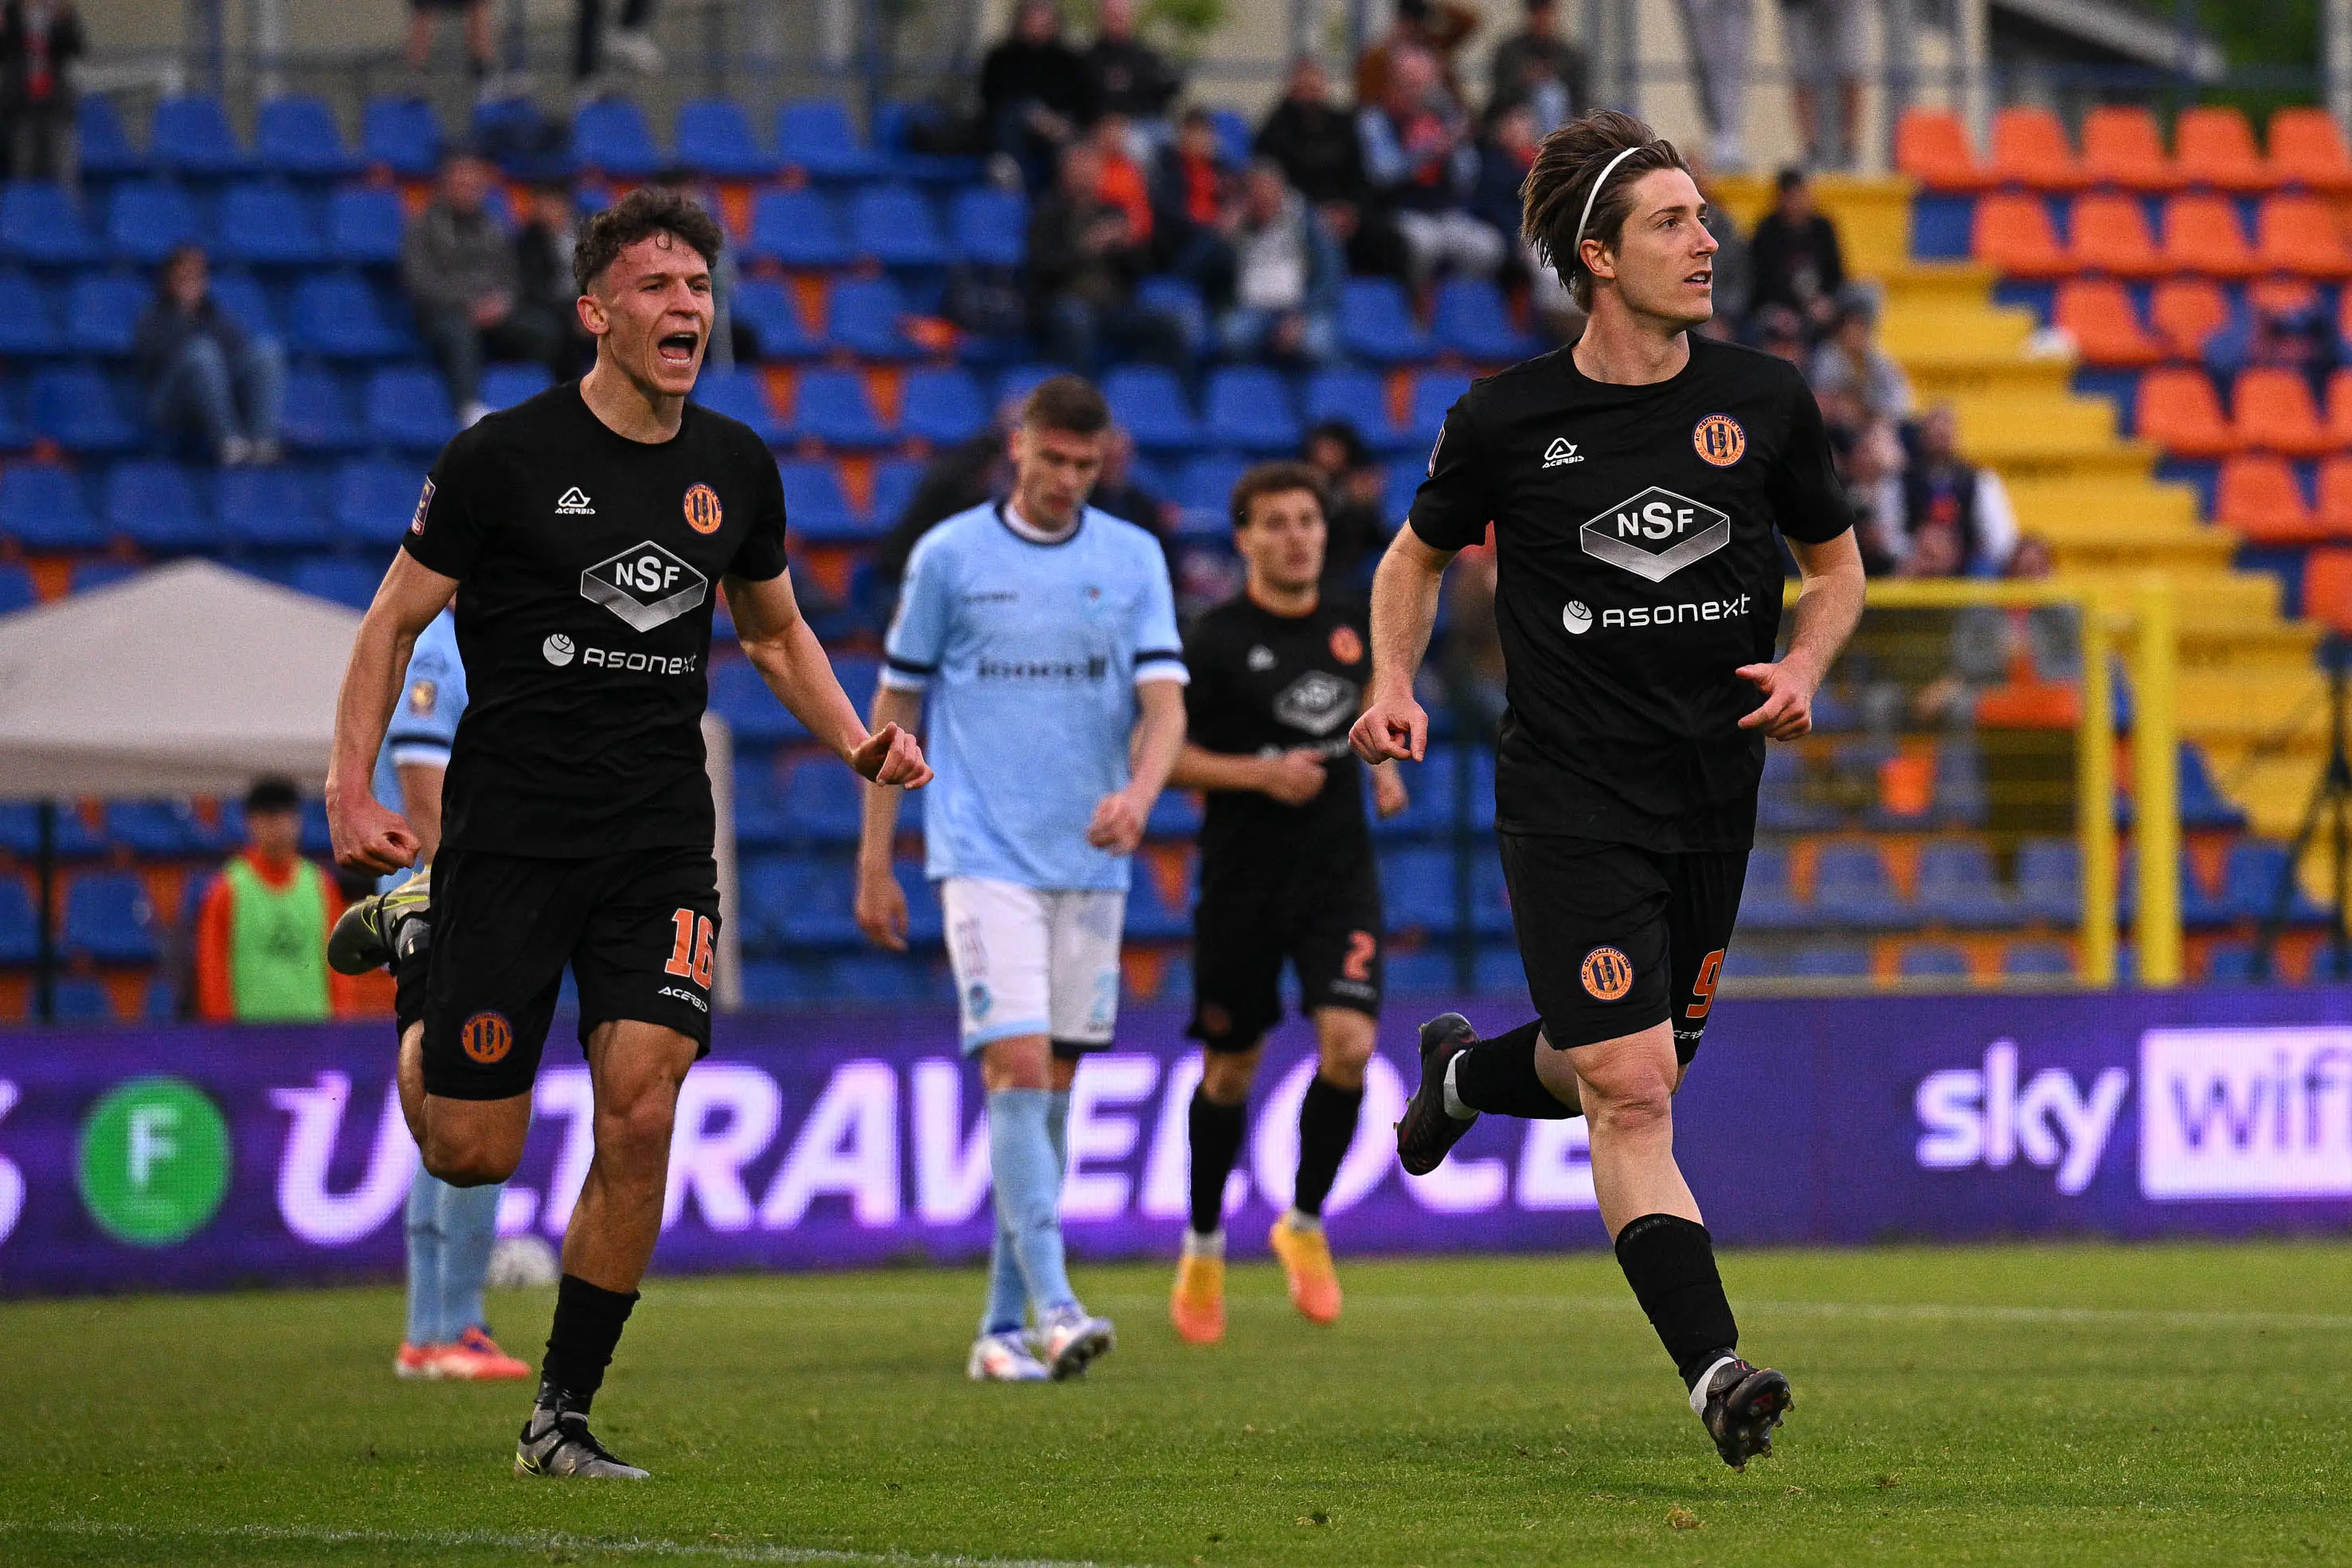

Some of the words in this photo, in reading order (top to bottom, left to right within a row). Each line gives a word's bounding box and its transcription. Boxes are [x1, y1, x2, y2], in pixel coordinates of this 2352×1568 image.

[1542, 455, 1585, 469] ACERBIS
[1617, 502, 1694, 540] NSF
[615, 556, 680, 592] NSF
[664, 908, 714, 990] 16
[1344, 929, 1376, 980] 2
[1685, 948, 1724, 1019] 9
[1916, 1038, 2129, 1195] sky
